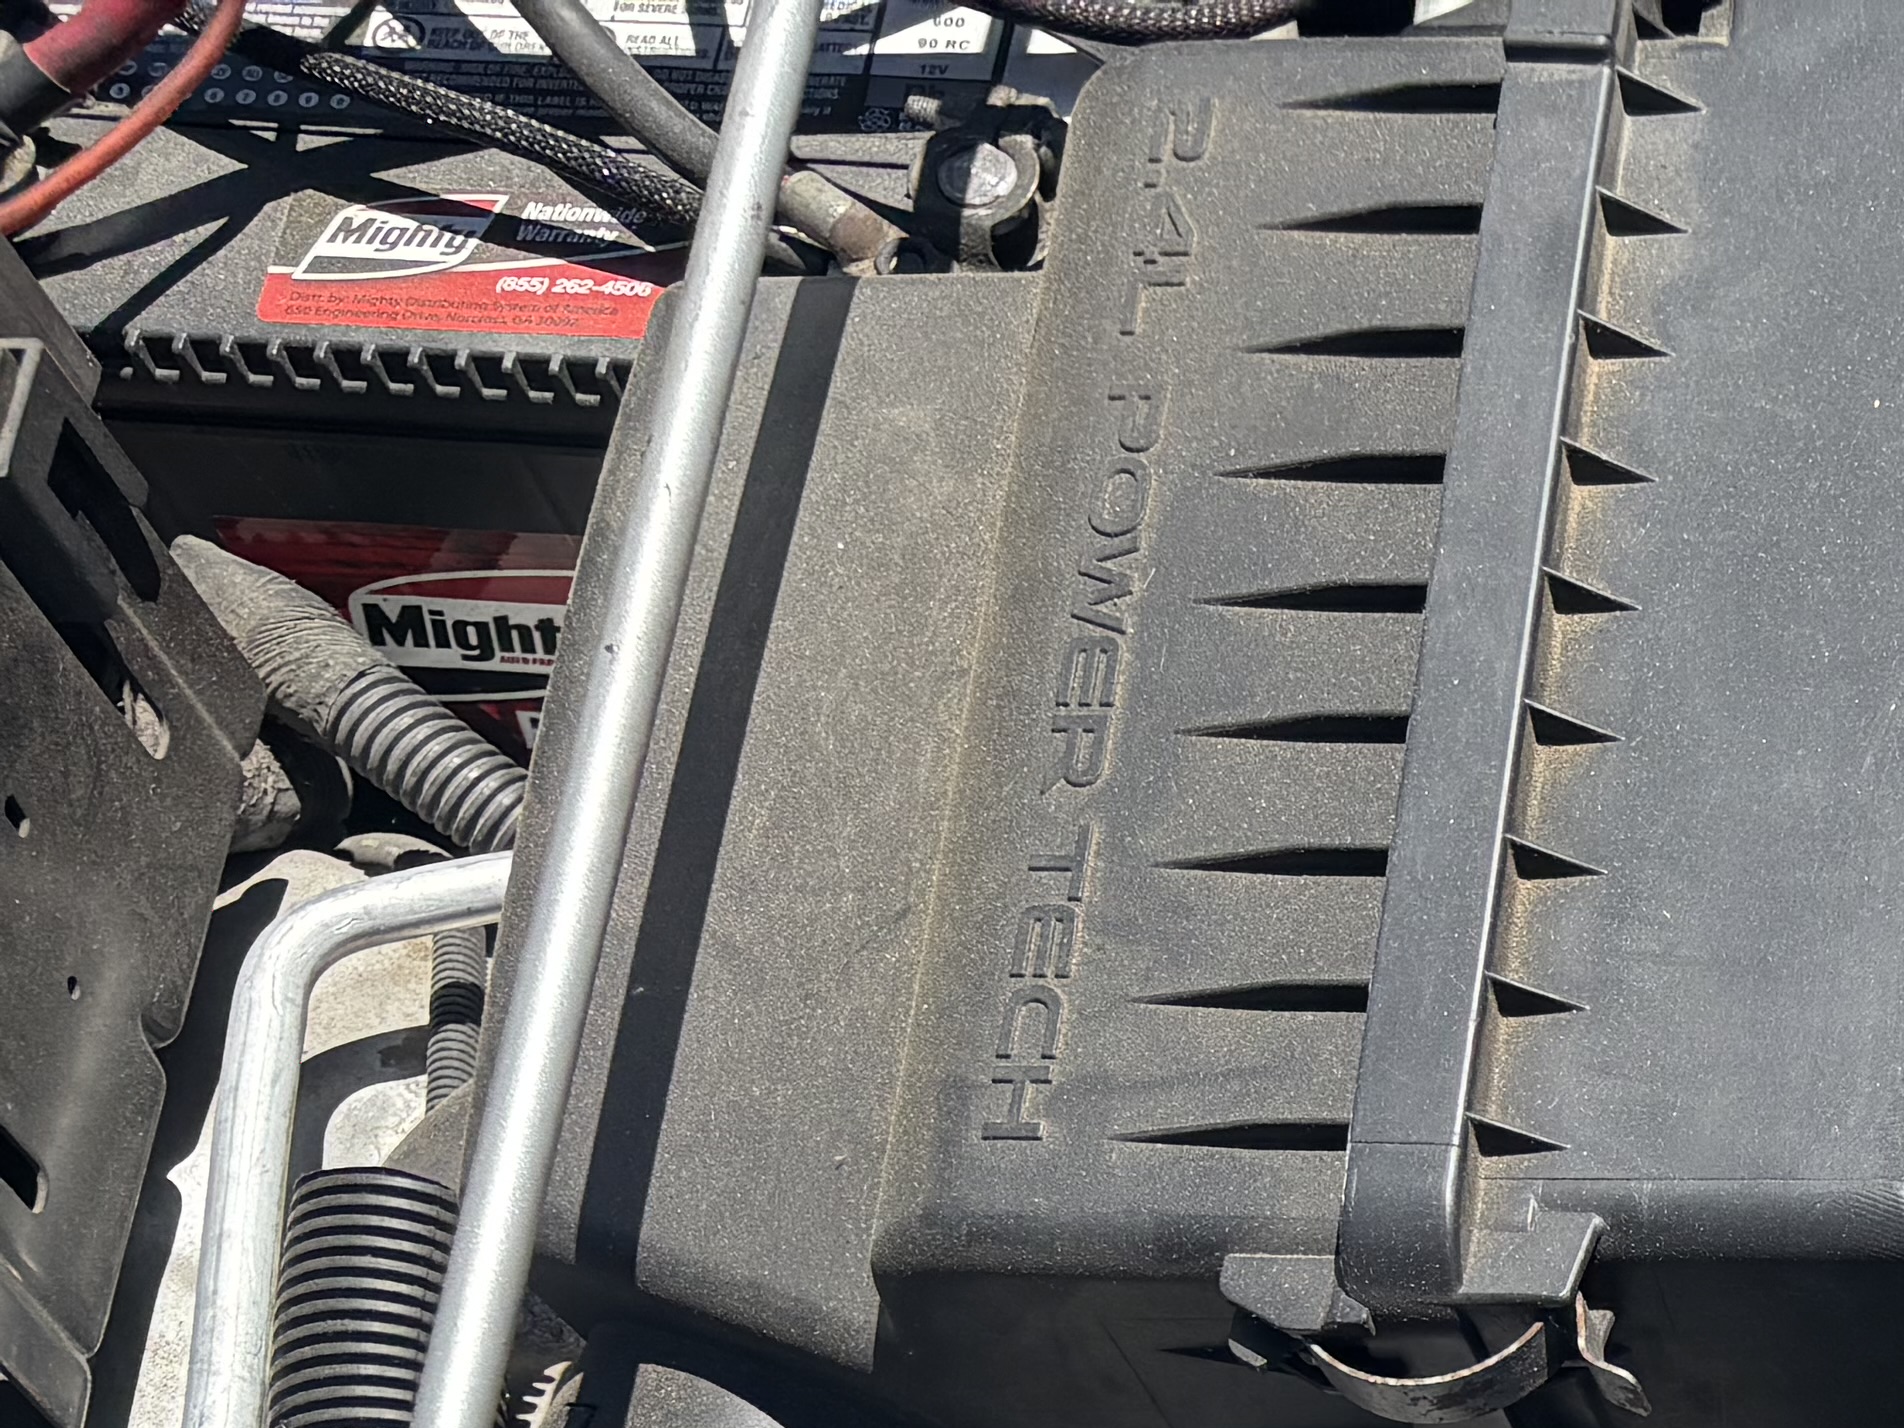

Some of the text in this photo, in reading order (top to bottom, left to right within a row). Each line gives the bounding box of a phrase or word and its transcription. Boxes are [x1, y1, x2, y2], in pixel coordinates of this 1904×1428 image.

[521, 200, 649, 226] Nationwide
[327, 215, 470, 257] Mighty
[515, 222, 621, 245] Warranty
[352, 294, 401, 309] Mighty
[495, 276, 549, 295] (855)
[1047, 391, 1168, 793] POWER
[361, 602, 562, 663] Might
[981, 823, 1094, 1142] TECH
